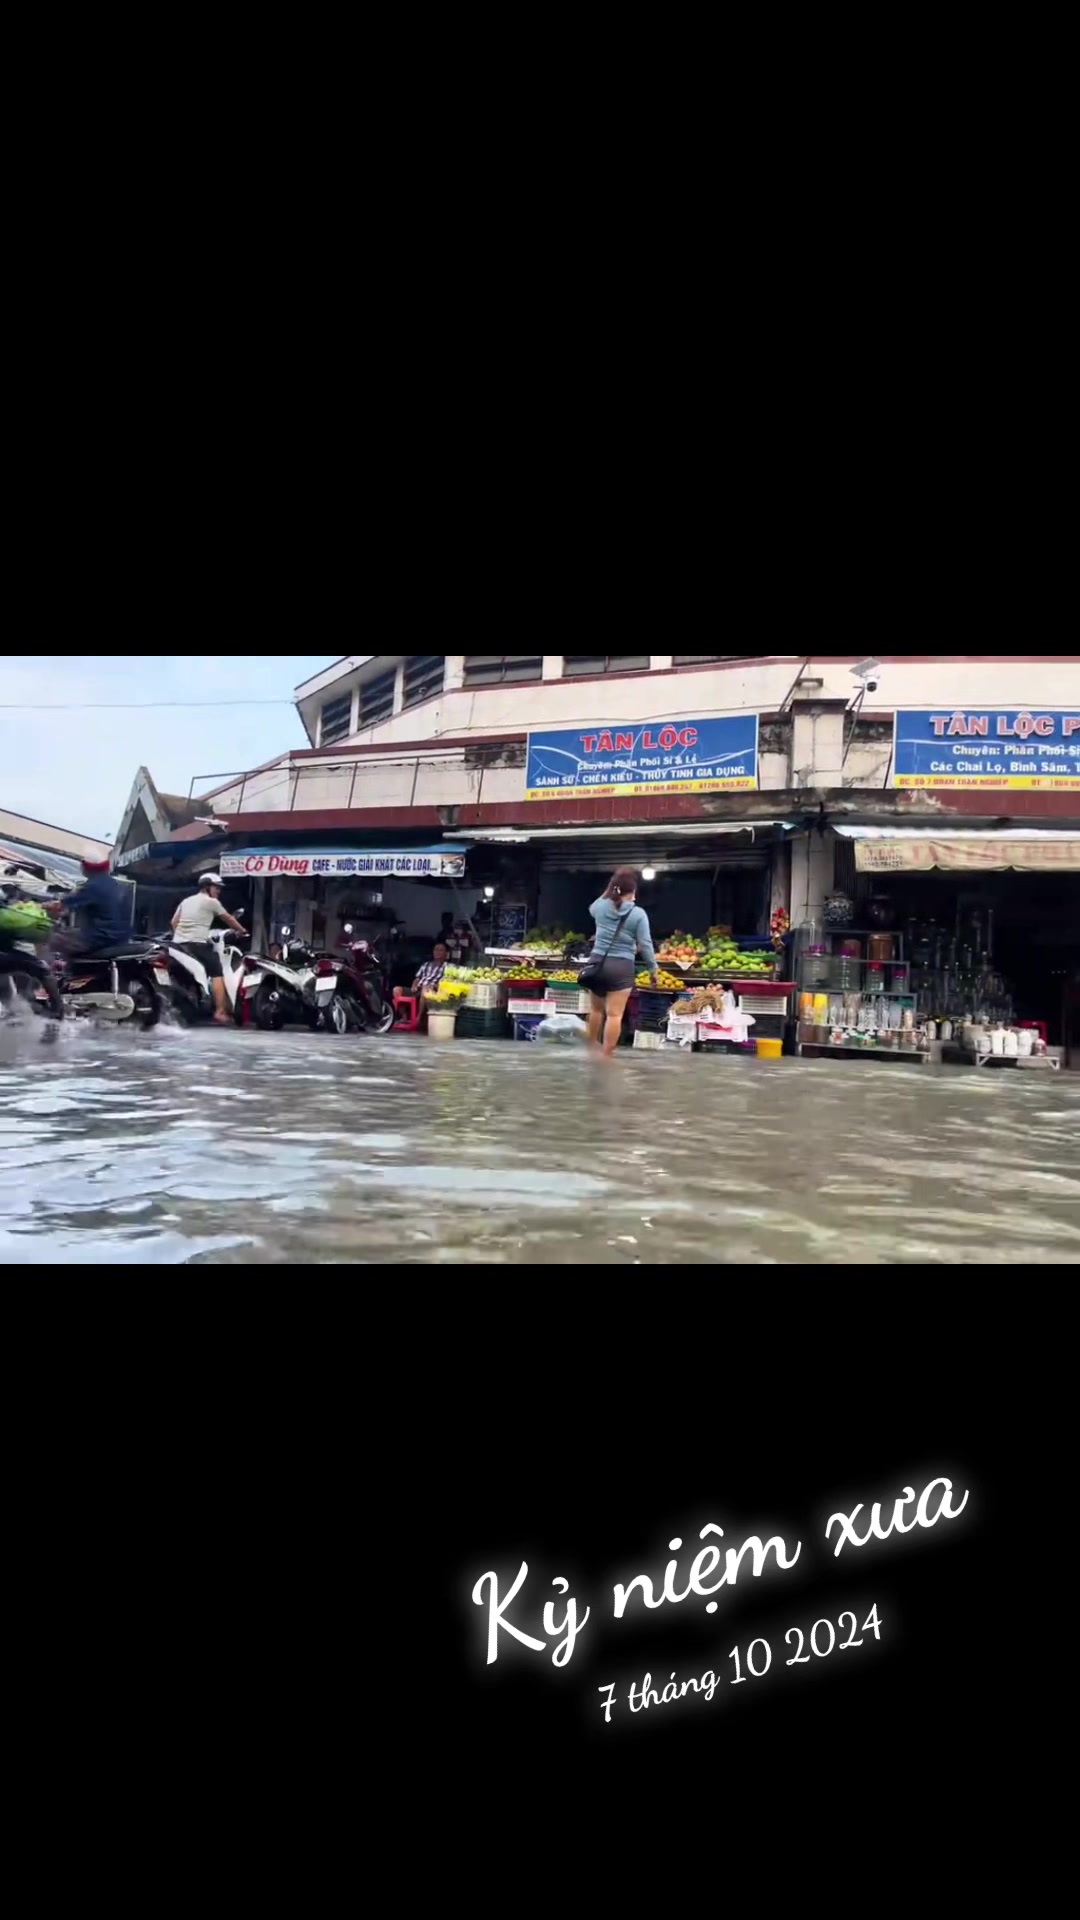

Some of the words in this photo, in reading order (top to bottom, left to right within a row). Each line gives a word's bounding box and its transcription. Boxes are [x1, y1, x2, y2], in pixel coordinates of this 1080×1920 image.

[929, 711, 988, 736] TÂN
[997, 711, 1054, 740] LỘC
[580, 729, 634, 753] TÂN
[642, 724, 698, 751] LỘC
[952, 744, 1000, 757] Chuyên:
[1004, 744, 1035, 756] Phân
[640, 755, 660, 767] Phối
[930, 761, 953, 771] Các
[956, 761, 983, 771] Chai
[986, 761, 1006, 773] Lọ,
[1010, 760, 1037, 772] Bình
[582, 772, 608, 784] CHÉN
[670, 770, 693, 778] TINH
[696, 768, 713, 777] GIA
[716, 766, 745, 777] DỤNG
[245, 856, 264, 872] Cô
[268, 855, 309, 874] Dùng
[312, 859, 330, 871] CAFE
[336, 857, 357, 871] NƯỚC
[396, 856, 412, 871] CÁC
